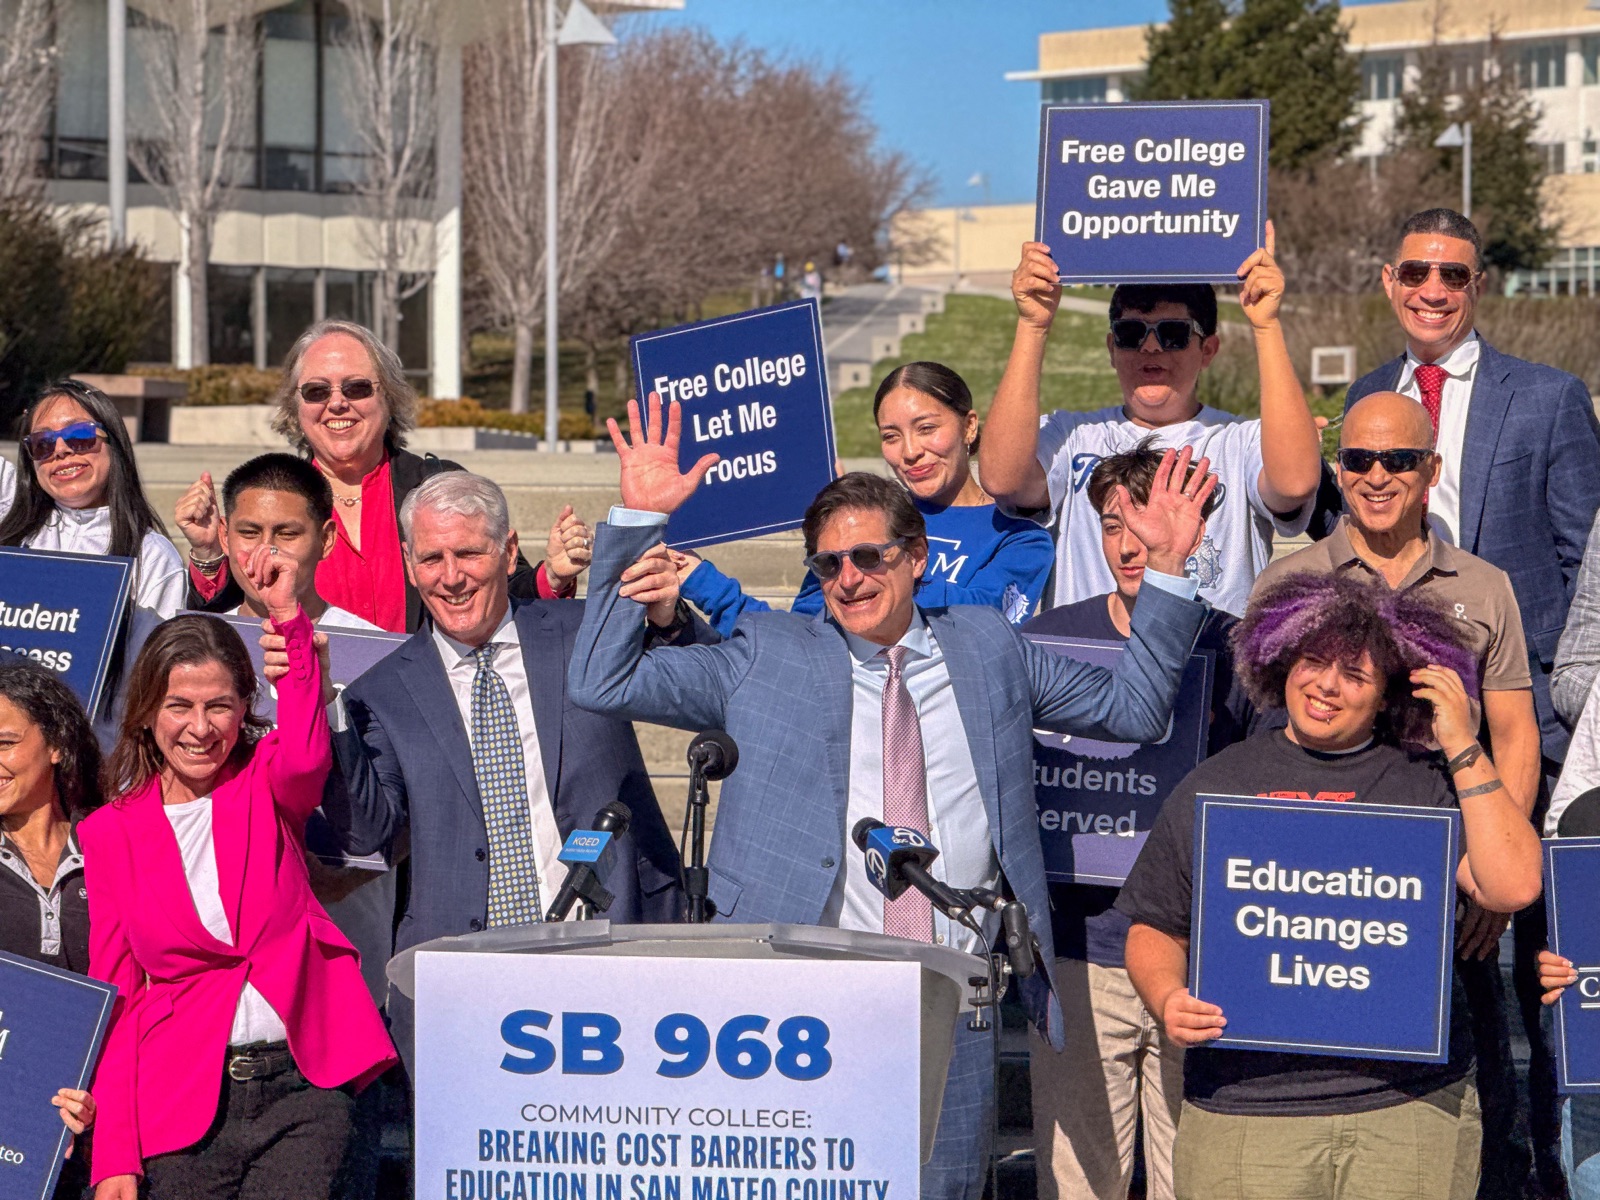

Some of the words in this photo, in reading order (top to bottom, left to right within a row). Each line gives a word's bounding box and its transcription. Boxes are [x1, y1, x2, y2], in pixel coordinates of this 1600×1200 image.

[1062, 139, 1126, 164] Free
[1134, 138, 1246, 167] College
[1087, 174, 1161, 199] Gave
[1170, 173, 1216, 198] Me
[1062, 208, 1240, 240] Opportunity
[654, 374, 708, 405] Free
[714, 353, 806, 387] College
[693, 409, 734, 442] Let
[738, 401, 777, 433] Me
[1036, 803, 1136, 837] erved
[572, 837, 600, 847] KQED
[1226, 858, 1422, 900] Education
[1235, 904, 1408, 950] Changes
[1269, 953, 1371, 991] Lives
[499, 1009, 625, 1076] SB
[654, 1012, 833, 1082] 968
[520, 1103, 682, 1126] COMMUNITY
[688, 1107, 813, 1130] COLLEGE:
[478, 1128, 606, 1164] BREAKING
[616, 1132, 681, 1167] COST
[691, 1134, 817, 1170] BARRIERS
[824, 1137, 855, 1171] TO
[446, 1168, 587, 1200] EDUCATION
[596, 1173, 622, 1200] IN
[630, 1174, 681, 1200] SAN
[692, 1176, 777, 1200] MATEO
[785, 1177, 890, 1200] COUNTY
